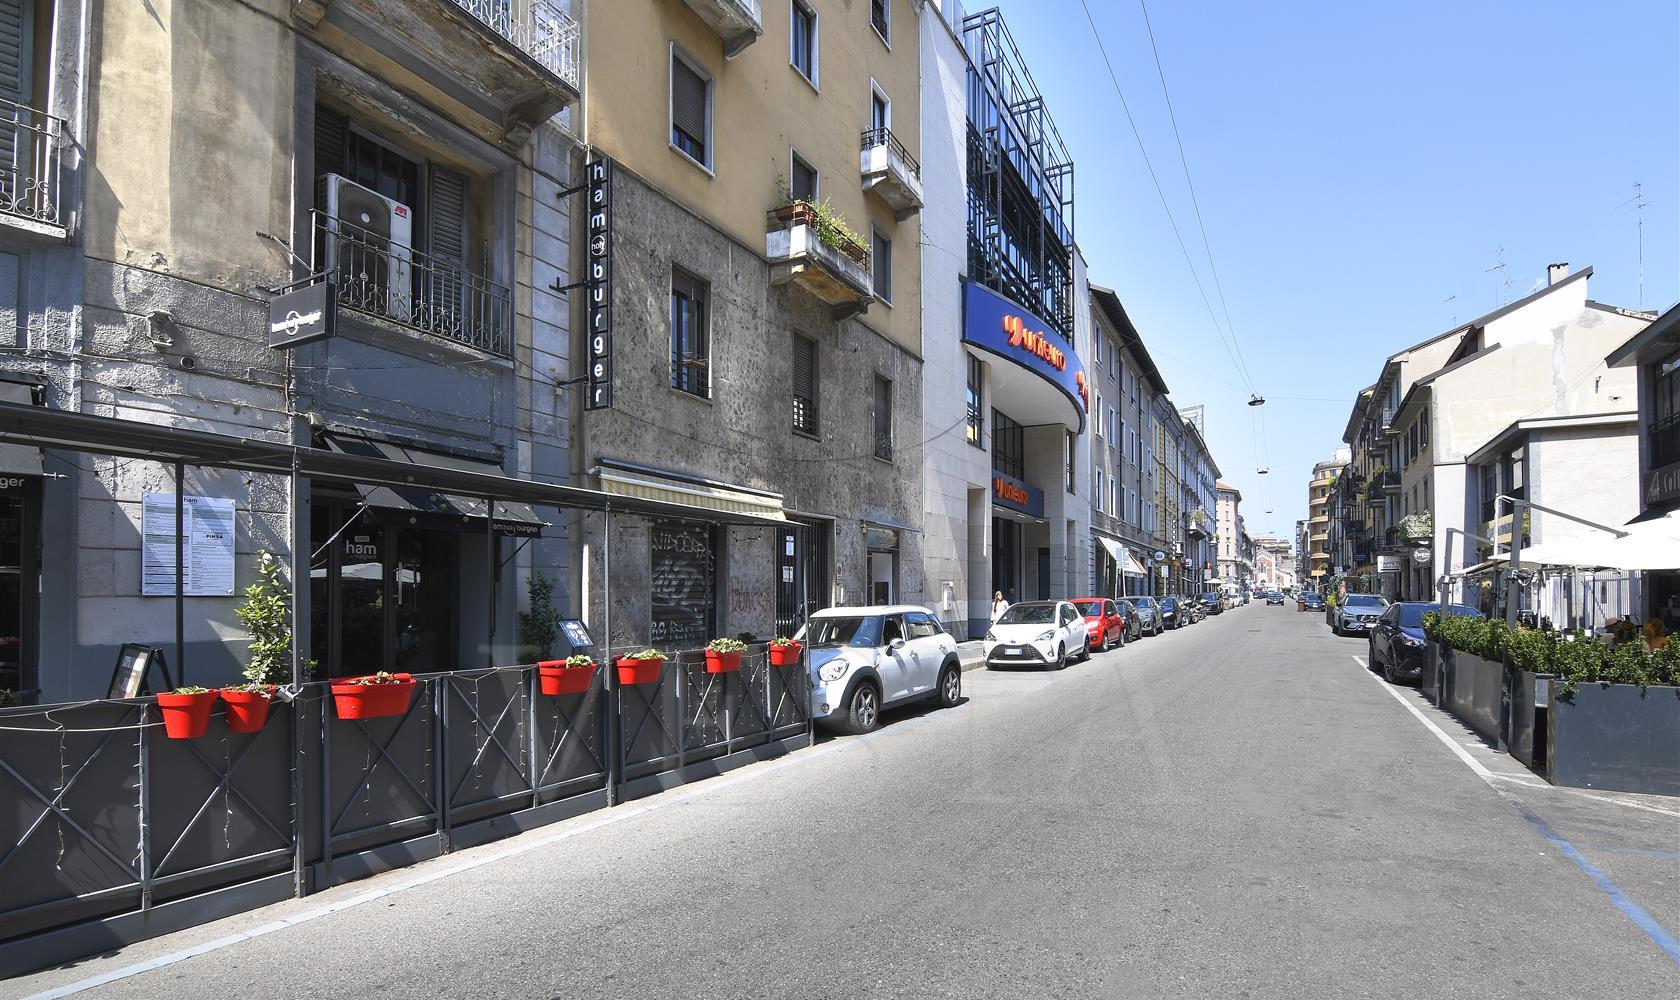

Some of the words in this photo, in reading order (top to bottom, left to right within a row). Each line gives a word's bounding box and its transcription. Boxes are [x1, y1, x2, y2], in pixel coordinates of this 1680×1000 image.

[591, 164, 606, 229] ham
[591, 240, 605, 251] holy
[593, 263, 604, 402] burger
[1022, 327, 1066, 372] unieuro
[346, 539, 377, 555] ham
